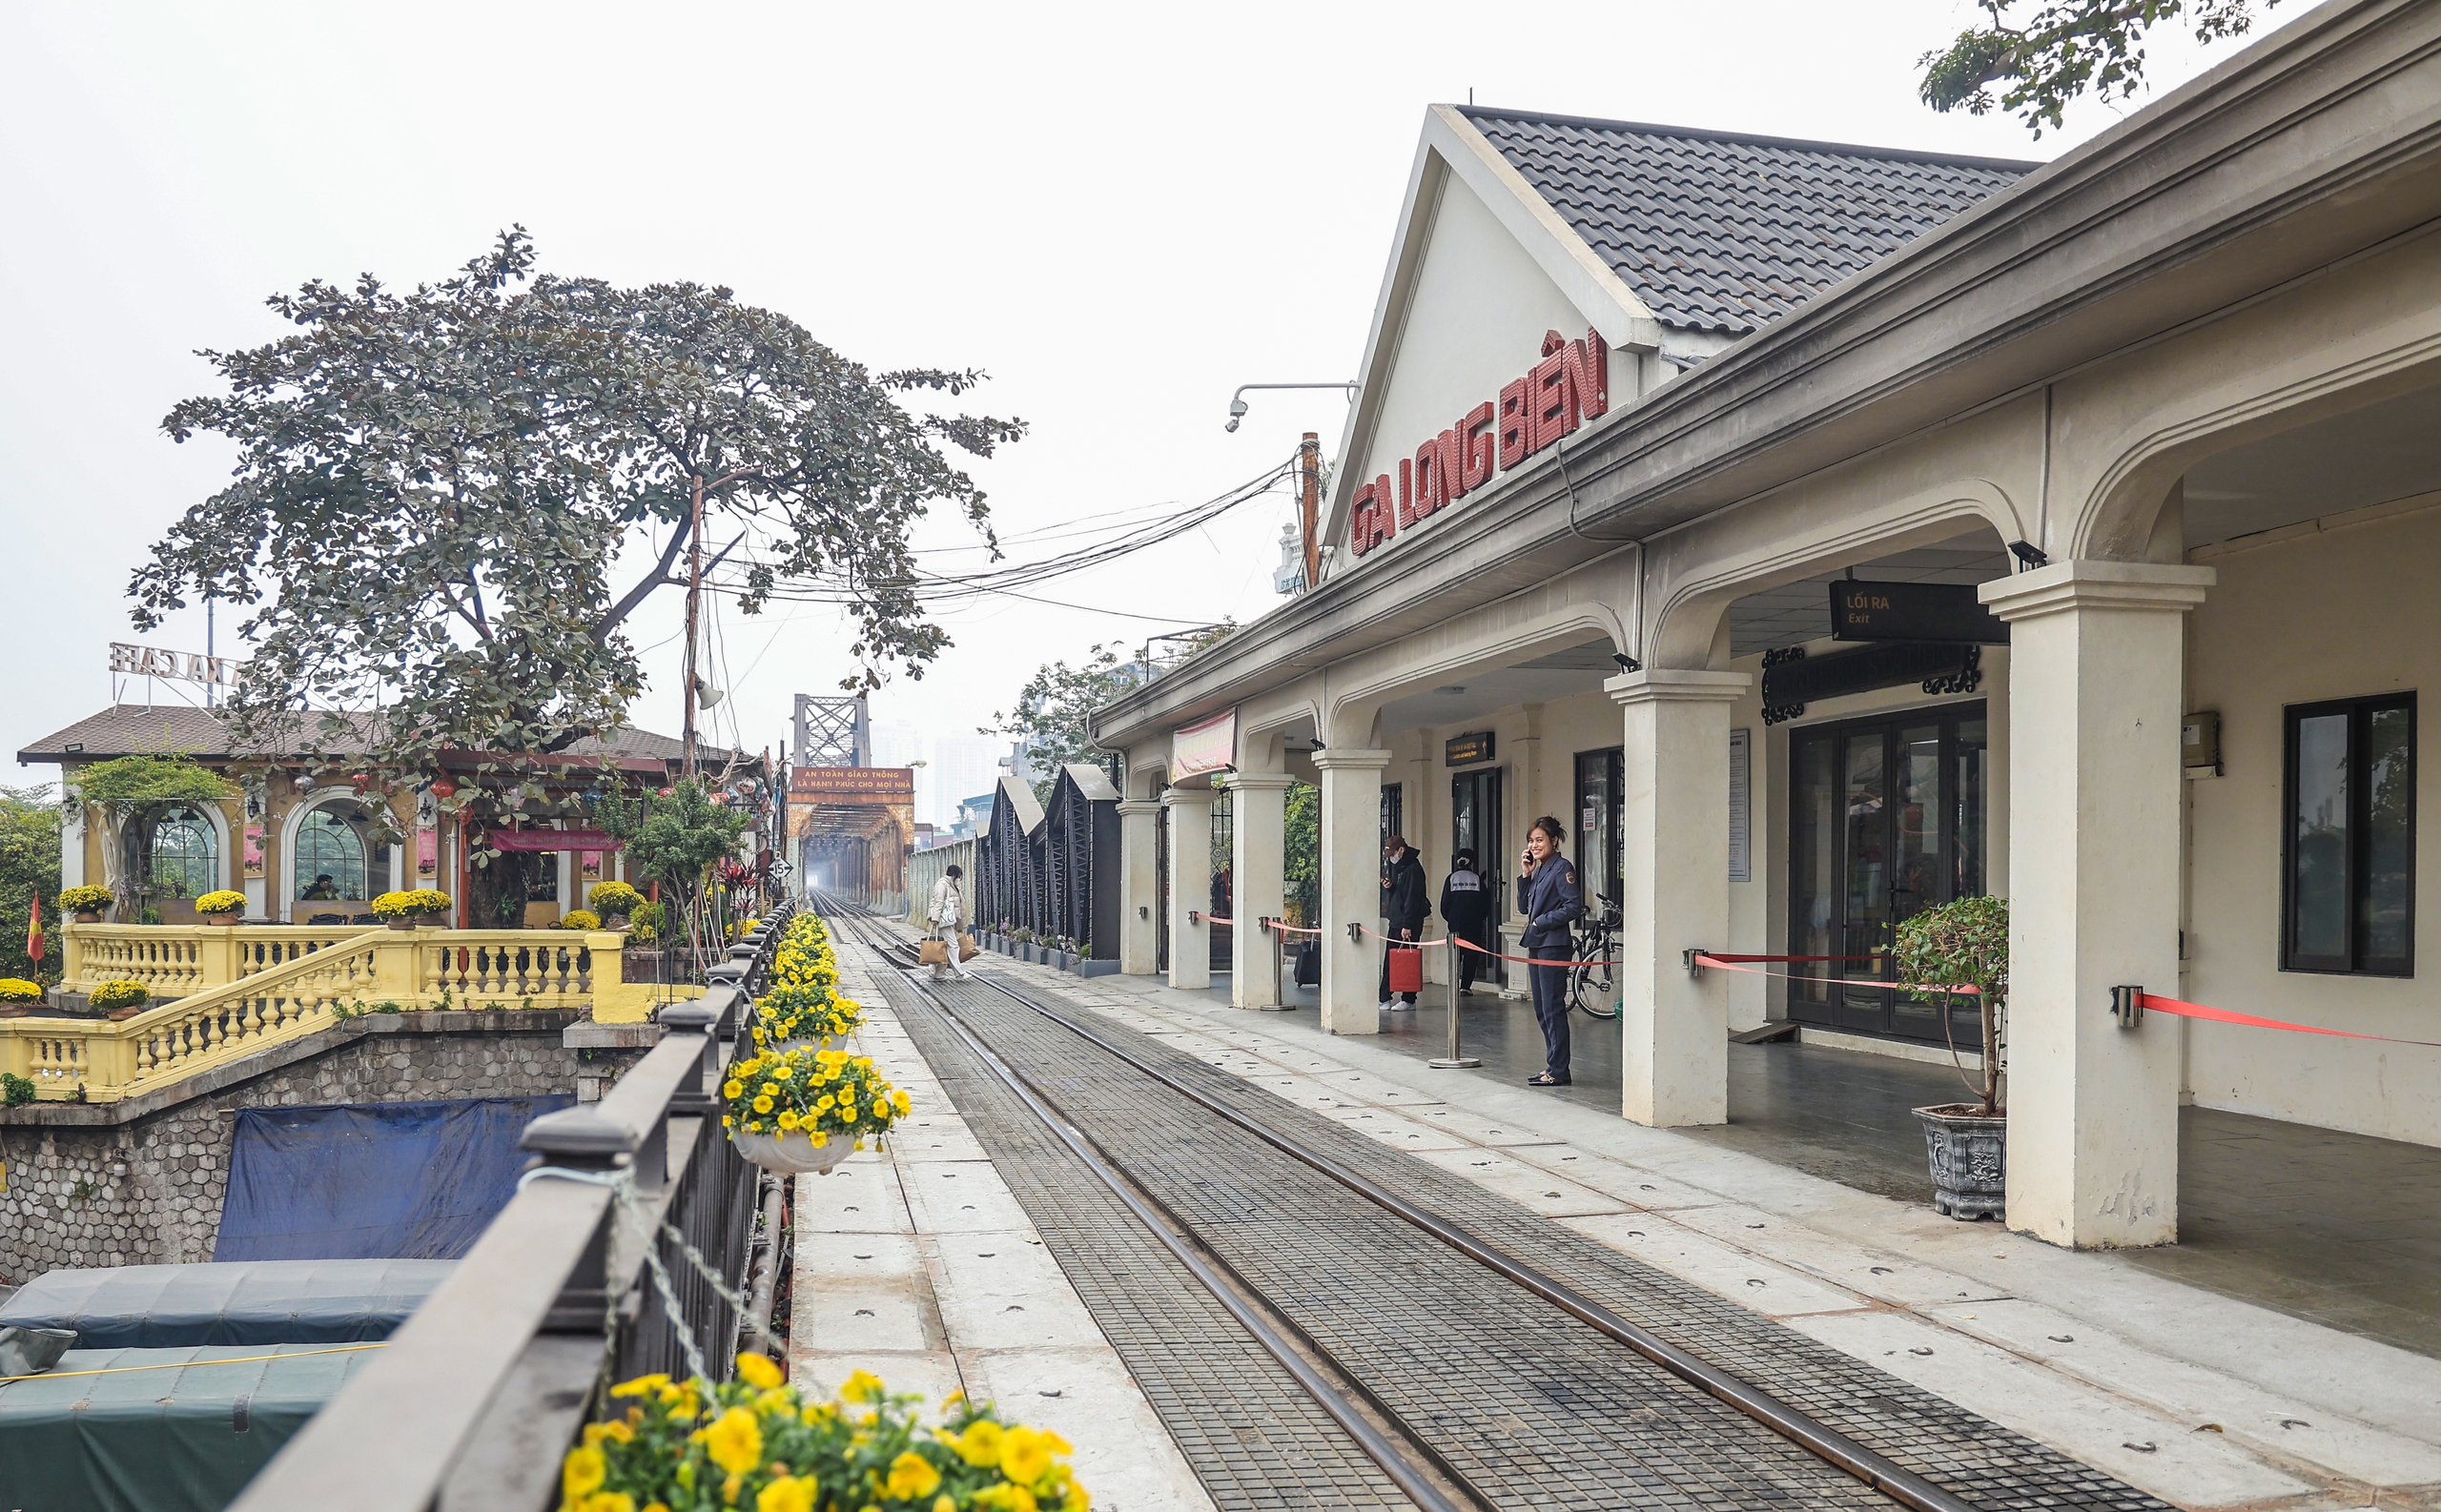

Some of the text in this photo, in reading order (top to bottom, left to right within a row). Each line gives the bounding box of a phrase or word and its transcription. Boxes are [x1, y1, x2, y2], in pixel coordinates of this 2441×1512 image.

[1351, 326, 1608, 557] GA LONG BIÊN
[1847, 591, 1890, 610] LỐI RA
[1848, 613, 1870, 623] Exit
[872, 769, 899, 779] THÔNG
[797, 779, 808, 787] LÀ
[810, 781, 832, 789] HẠNH
[835, 778, 855, 787] PHÚC
[876, 780, 892, 790] MỌI
[894, 779, 911, 788] NHÀ
[774, 864, 784, 875] 15
